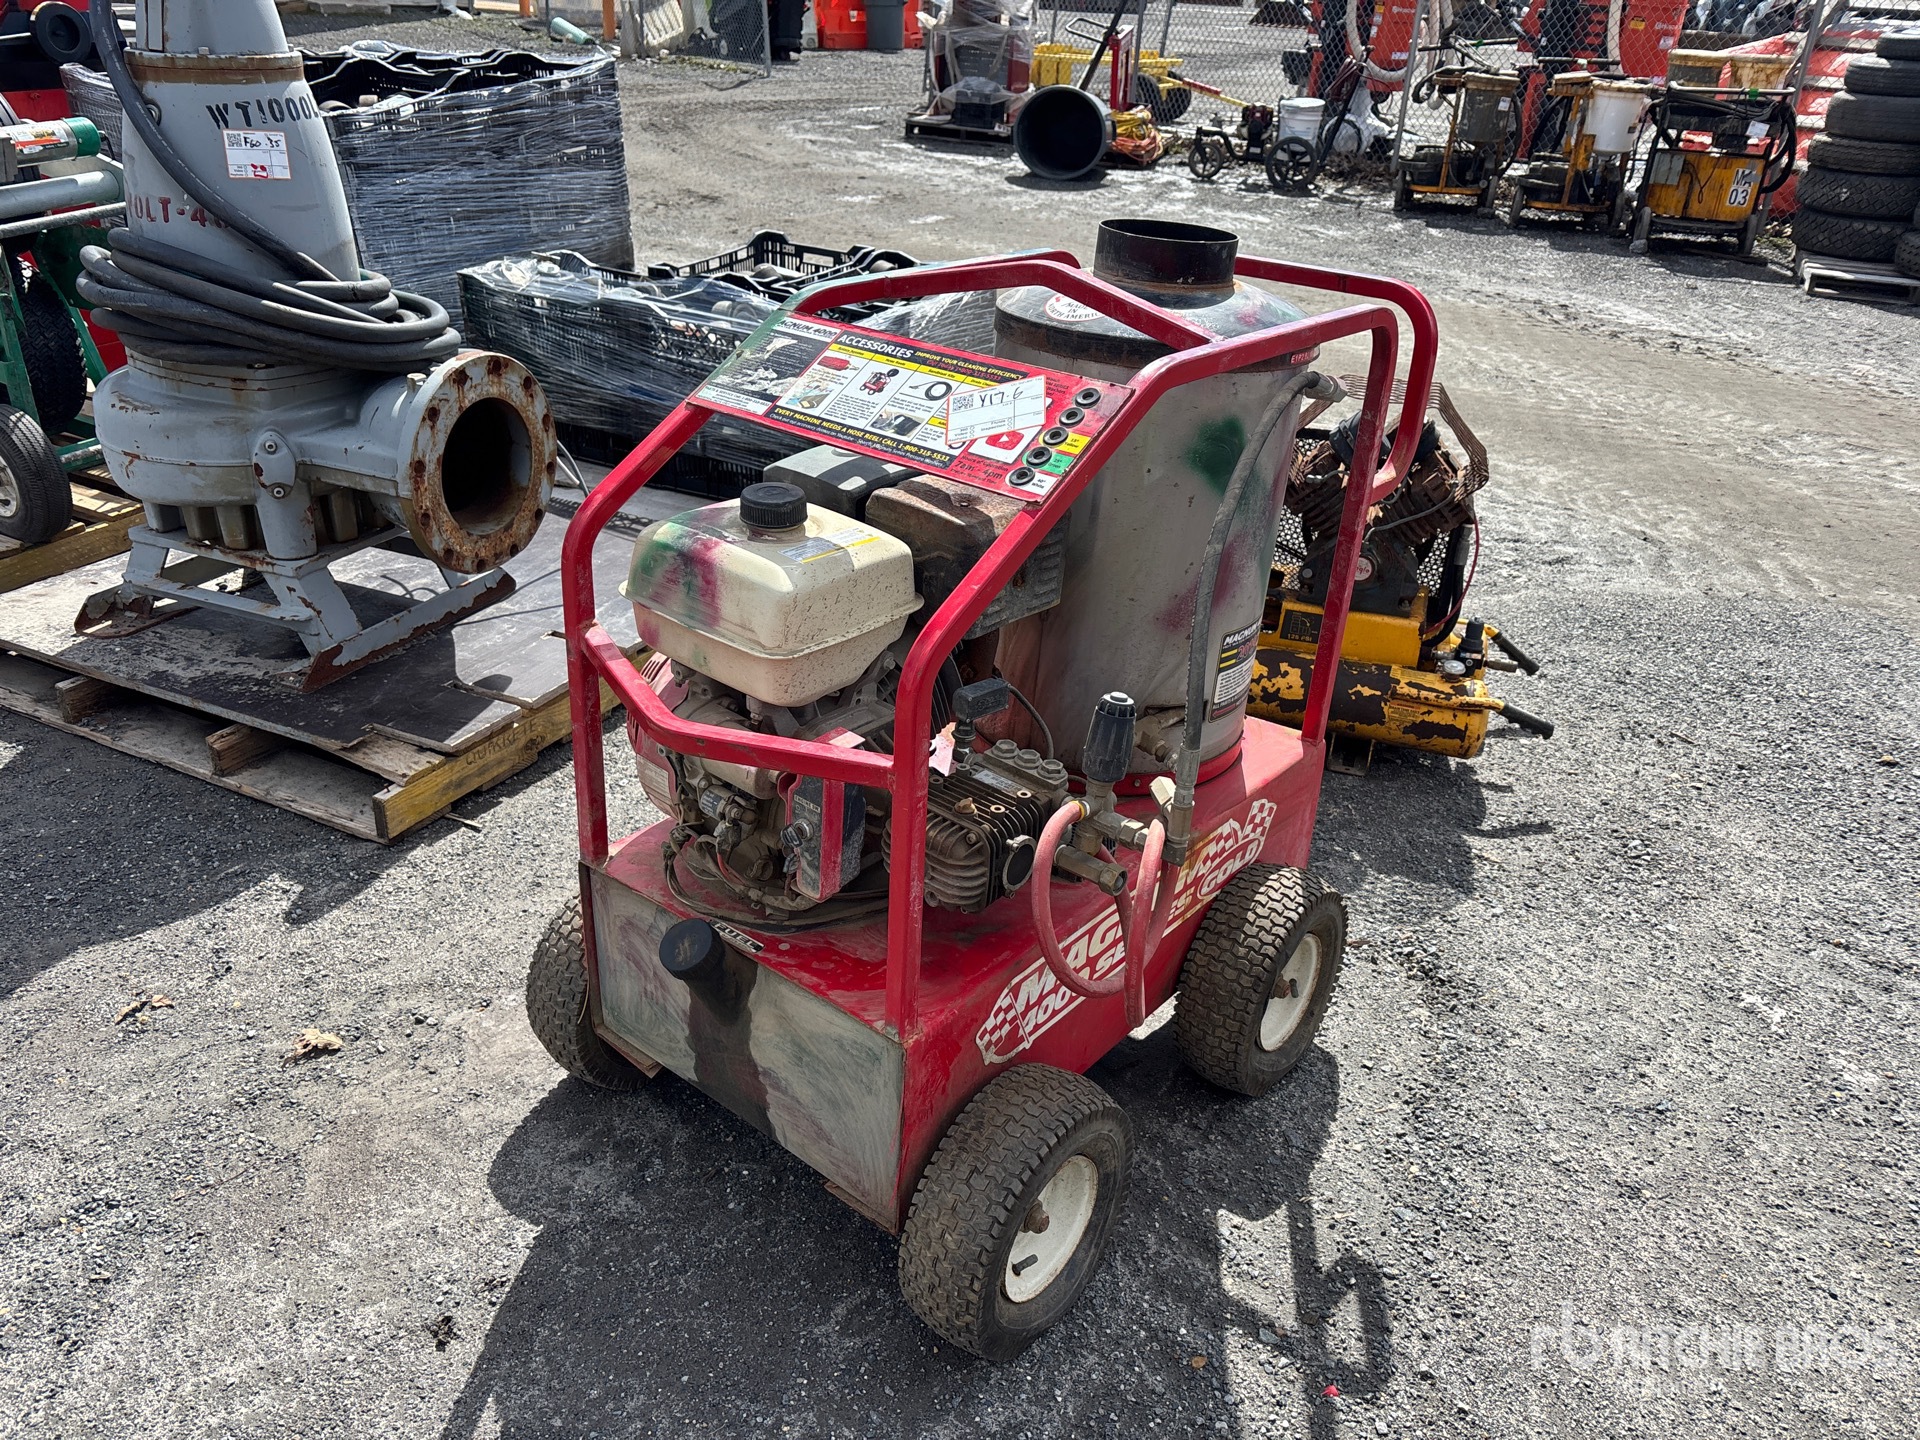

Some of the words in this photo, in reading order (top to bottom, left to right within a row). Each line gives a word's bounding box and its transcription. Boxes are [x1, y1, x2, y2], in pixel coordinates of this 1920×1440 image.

[1728, 188, 1750, 206] 03
[837, 334, 914, 358] ACCESSORIES
[914, 351, 942, 361] IMPROVE
[941, 357, 958, 365] YOUR
[957, 361, 988, 372] CLEANING
[987, 367, 1024, 380] EFFICIENCY
[774, 407, 794, 417] EVERY
[793, 413, 822, 425] MACHINE
[821, 420, 842, 431] NEEDS
[847, 428, 865, 438] HOSE
[864, 433, 881, 443] REEL!
[882, 437, 897, 447] CALL
[897, 442, 950, 462] 1-800-315-5533
[955, 460, 974, 472] 7am
[982, 468, 1003, 480] 4pm
[1200, 842, 1259, 896] GOLD
[714, 922, 757, 950] FUEL
